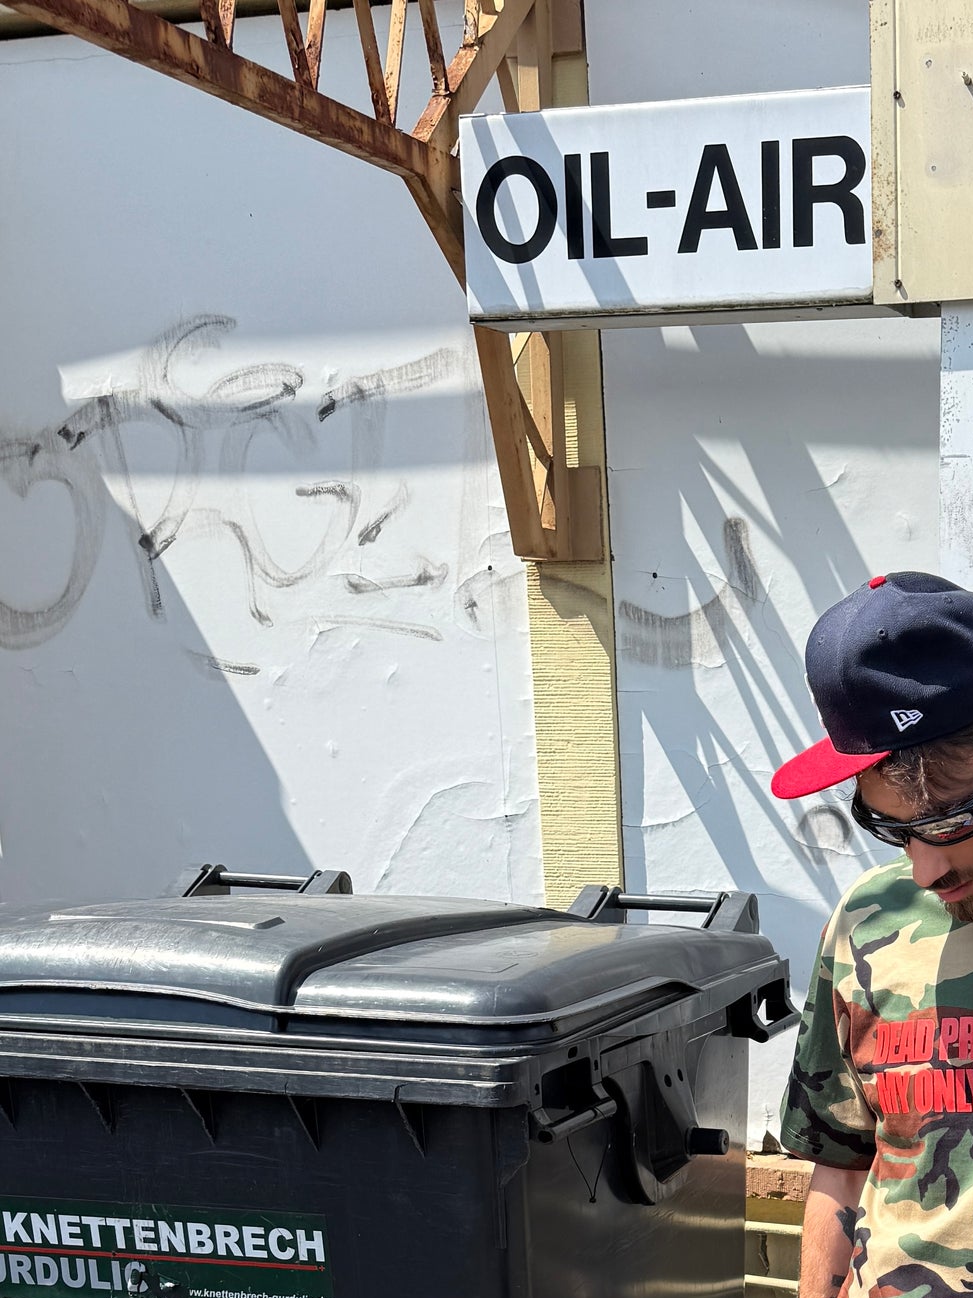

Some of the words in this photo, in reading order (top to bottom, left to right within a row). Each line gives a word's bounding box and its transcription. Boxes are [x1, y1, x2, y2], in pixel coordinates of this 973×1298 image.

[475, 135, 866, 264] OIL-AIR
[872, 1018, 936, 1066] DEAD
[876, 1070, 911, 1115] MY
[2, 1211, 326, 1263] KNETTENBRECH
